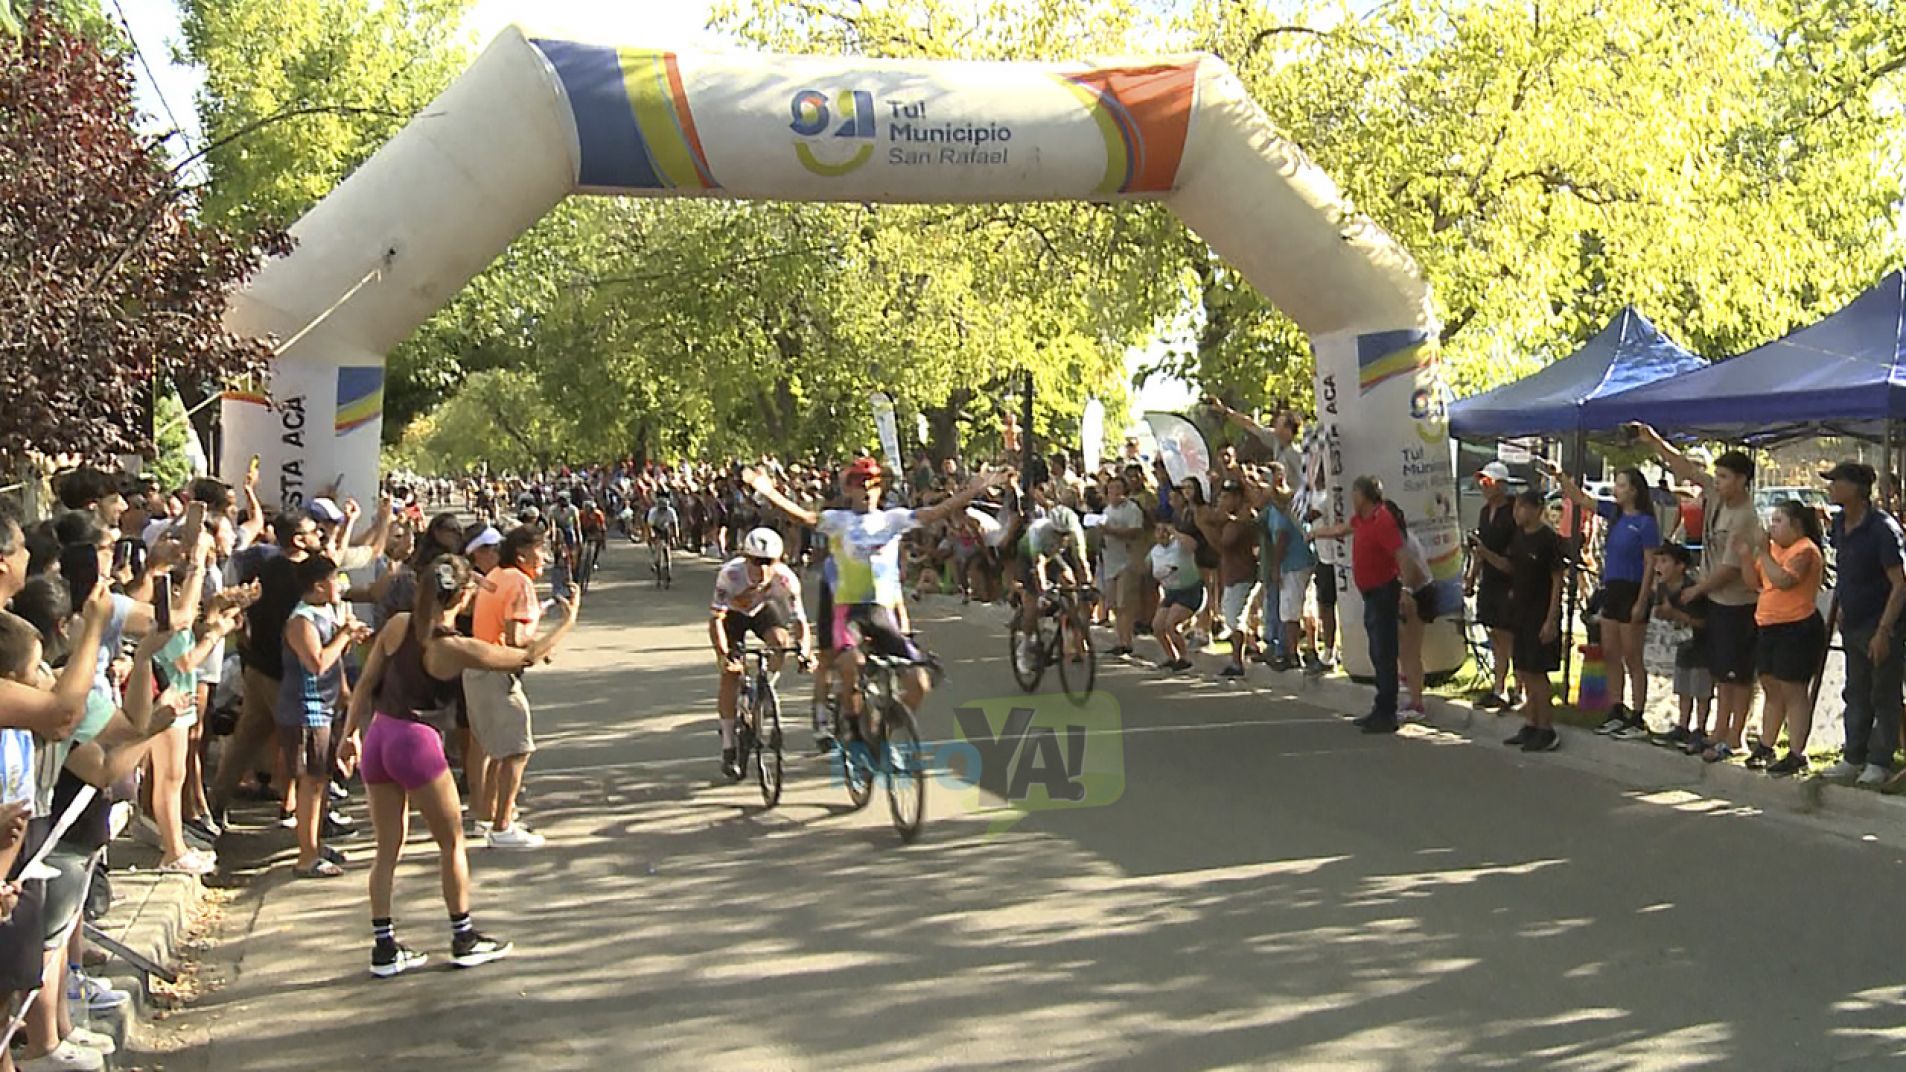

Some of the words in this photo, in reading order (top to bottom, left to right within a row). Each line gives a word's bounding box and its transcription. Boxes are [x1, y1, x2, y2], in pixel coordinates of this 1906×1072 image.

[888, 100, 926, 119] Tu!
[890, 123, 1011, 145] Municipio
[889, 147, 931, 164] San
[939, 147, 1007, 164] Rafael
[1333, 485, 1346, 558] PAION
